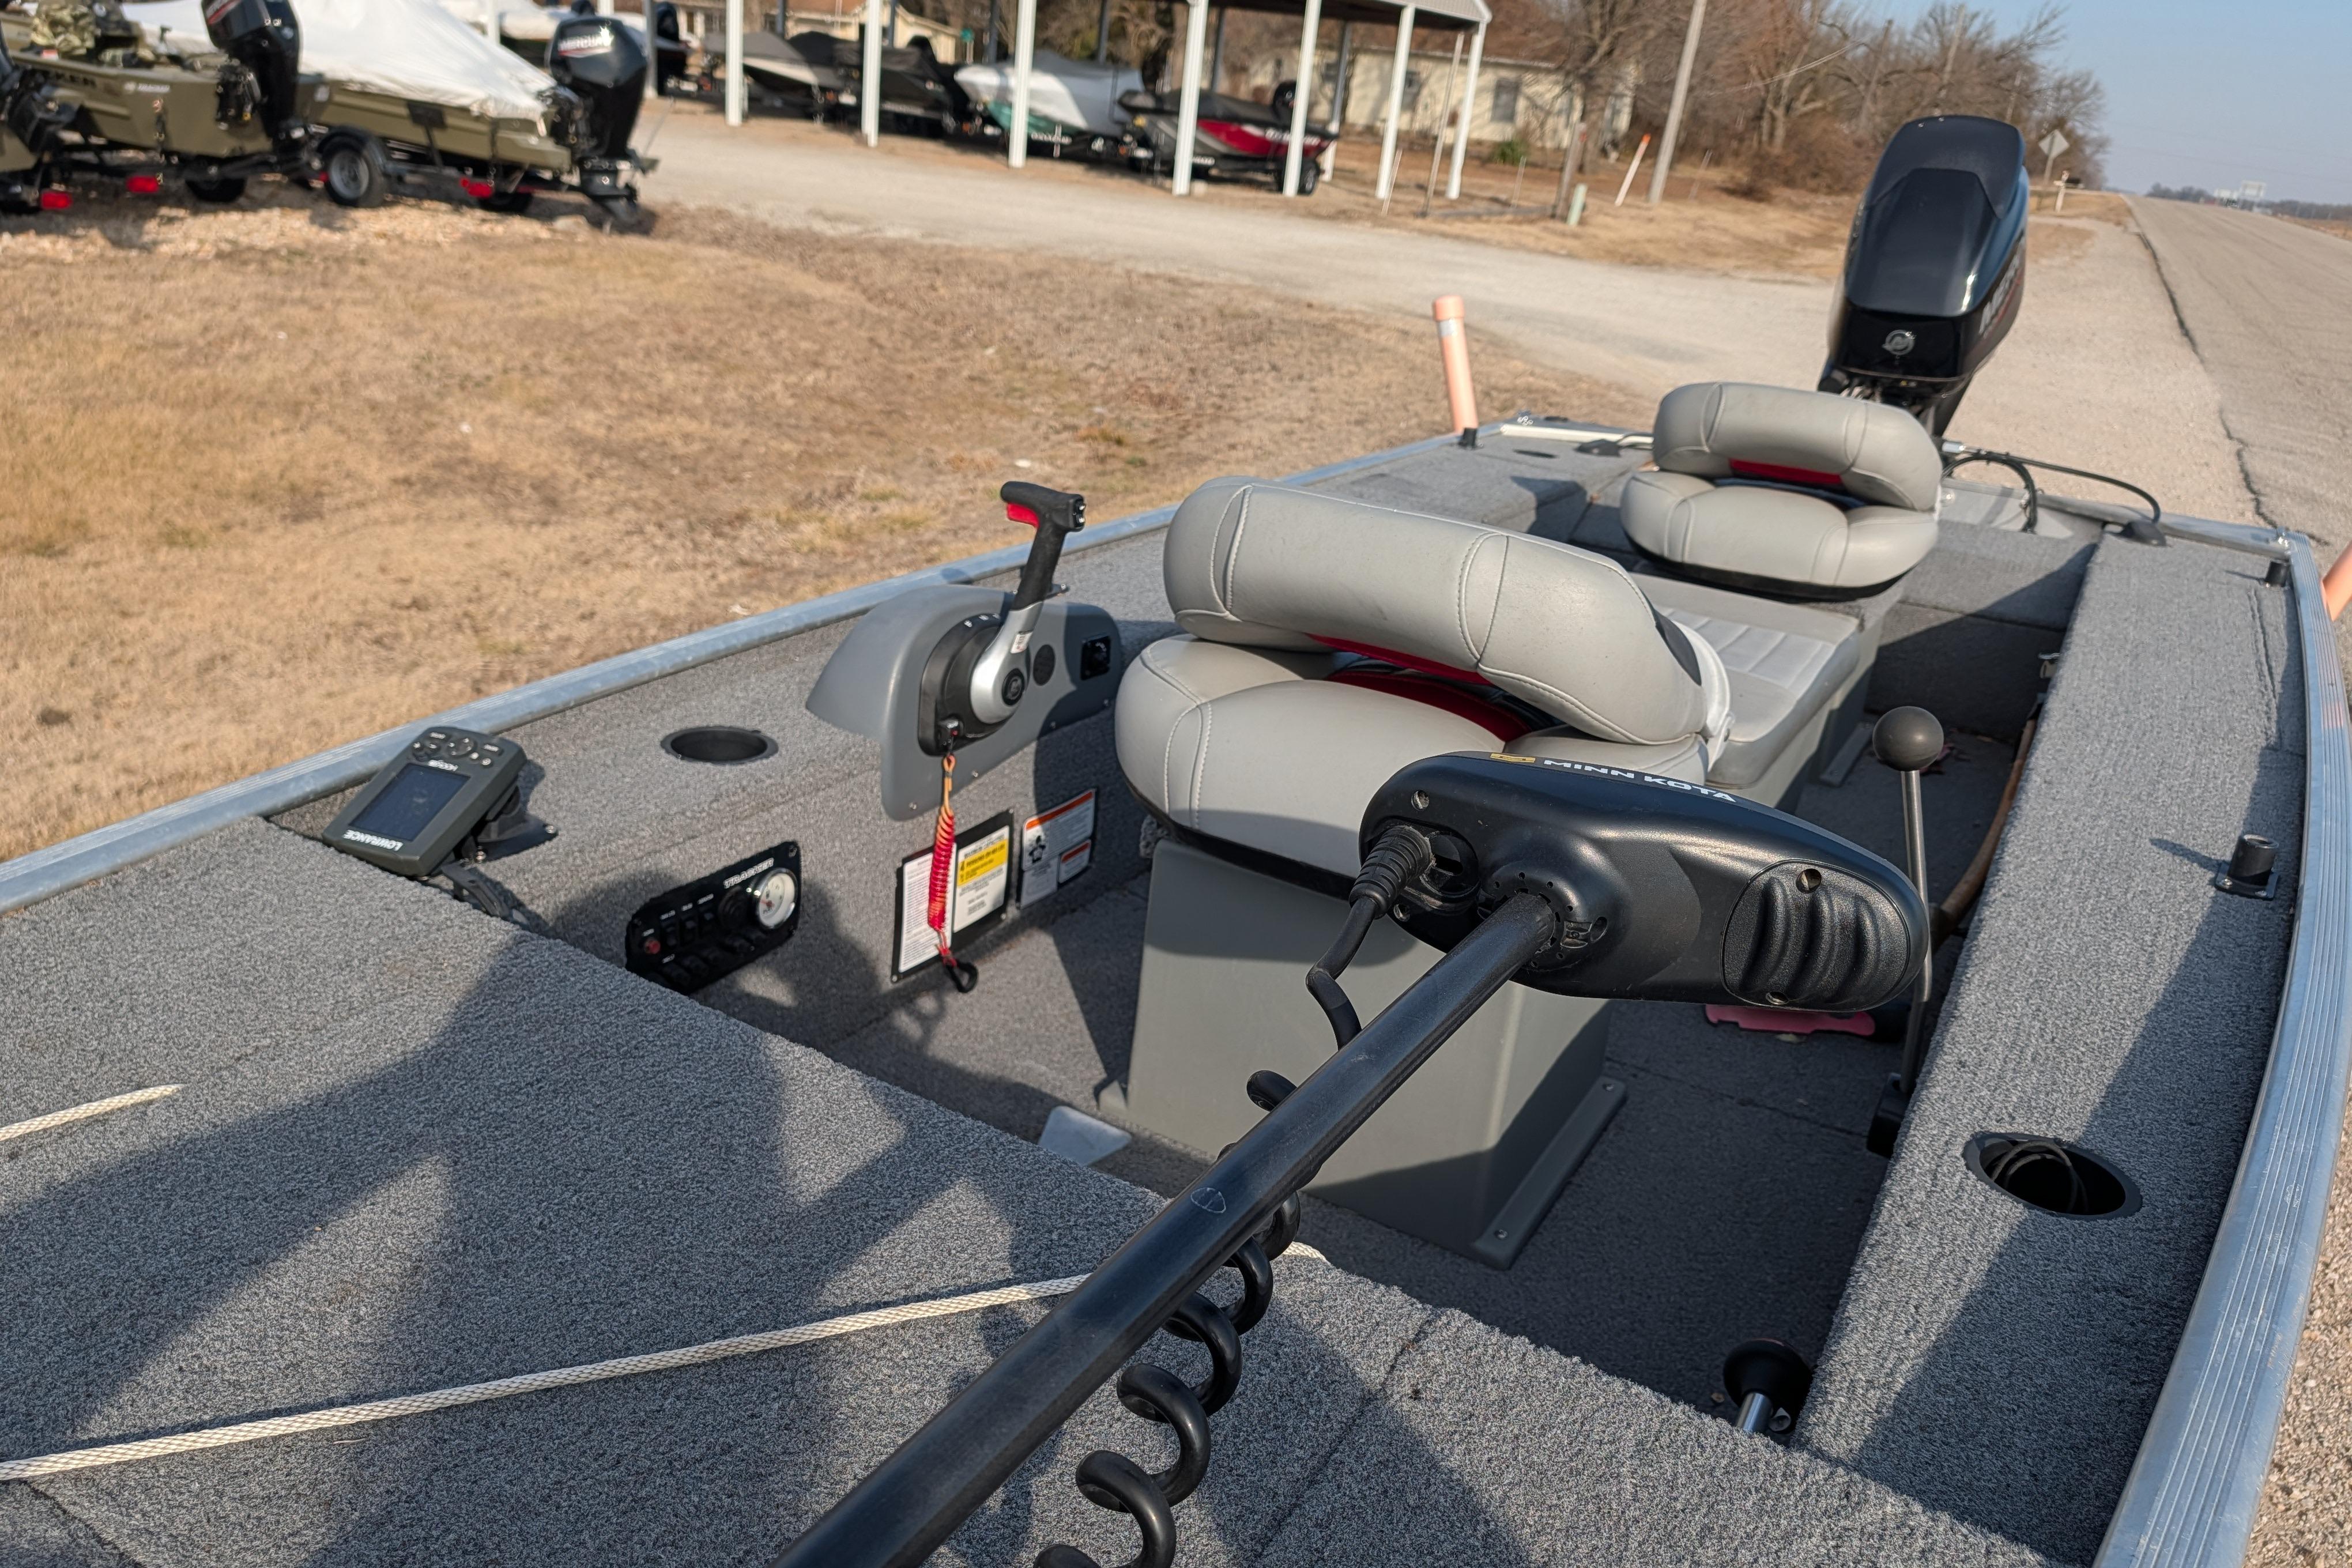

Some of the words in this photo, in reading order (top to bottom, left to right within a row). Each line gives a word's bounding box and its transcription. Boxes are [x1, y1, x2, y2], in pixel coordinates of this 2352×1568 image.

[1543, 759, 1634, 779] MINN
[1644, 775, 1737, 802] KOTA
[342, 829, 404, 851] LOWRANCE
